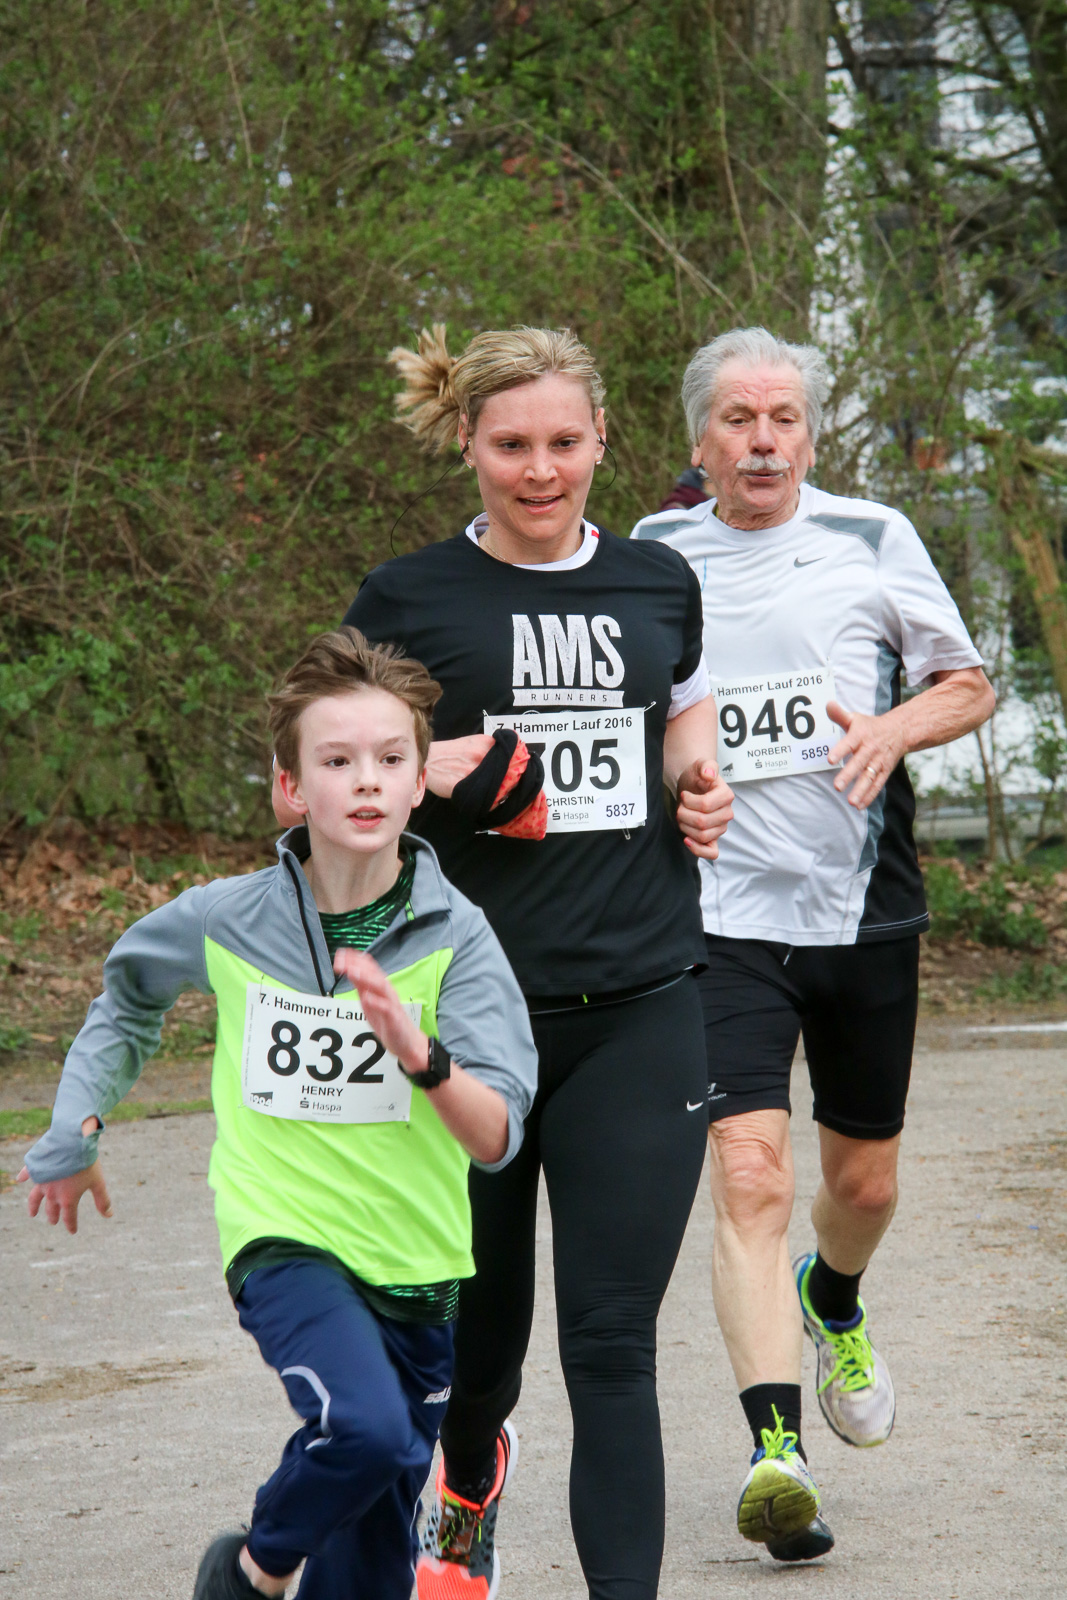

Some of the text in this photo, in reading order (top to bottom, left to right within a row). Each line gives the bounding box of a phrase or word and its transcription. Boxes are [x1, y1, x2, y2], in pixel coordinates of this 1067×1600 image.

[512, 614, 625, 688] AMS
[717, 684, 764, 697] Hammer
[767, 679, 793, 691] Lauf
[796, 675, 823, 687] 2016
[531, 693, 608, 702] RUNNERS
[513, 720, 569, 733] Hammer
[573, 718, 601, 731] Lauf
[604, 716, 633, 729] 2016
[719, 695, 815, 748] 946
[747, 745, 792, 758] NORBERT
[801, 745, 830, 760] 5859
[765, 760, 788, 768] Haspa
[546, 796, 595, 807] CHRISTIN
[563, 811, 589, 822] Haspa
[606, 803, 636, 817] 5837
[259, 993, 368, 1021] 7. Hammer Lau
[267, 1020, 387, 1084] 832
[301, 1085, 344, 1097] HENRY
[312, 1101, 342, 1112] Haspa
